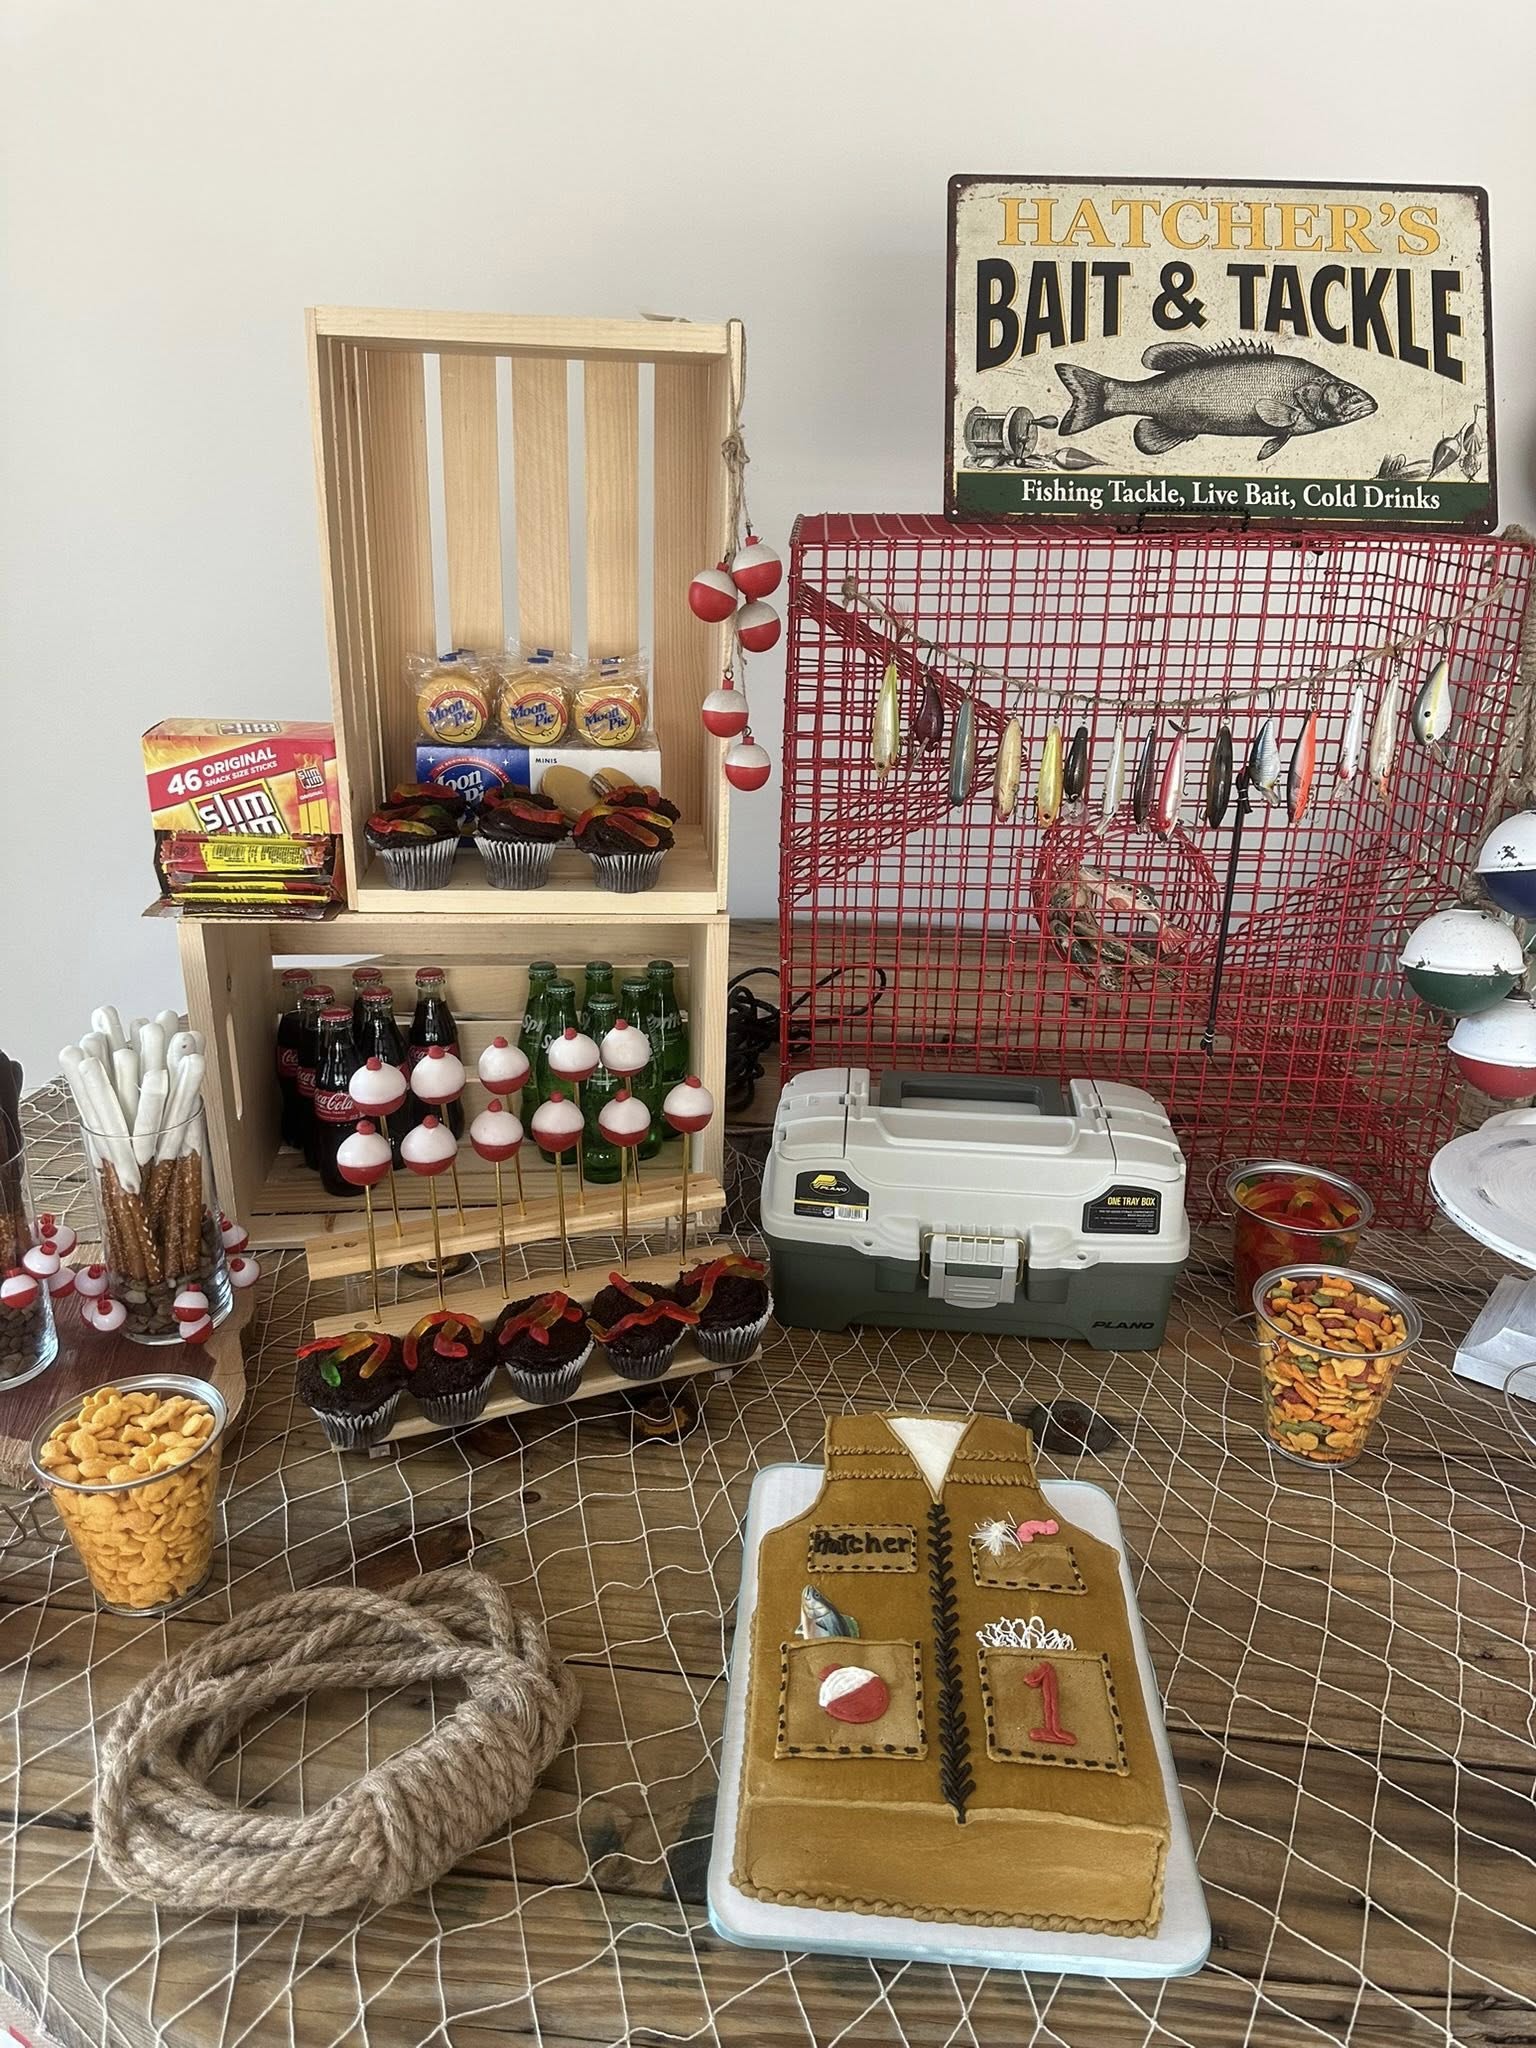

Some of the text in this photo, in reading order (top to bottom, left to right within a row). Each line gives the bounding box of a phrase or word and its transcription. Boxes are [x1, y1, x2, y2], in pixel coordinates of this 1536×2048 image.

[997, 197, 1441, 256] HATCHER’S
[976, 257, 1467, 385] BAIT & TACKLE
[1021, 478, 1440, 510] Fishing Tackle, Live Bait, Cold Drinks
[427, 700, 463, 725] Moon
[454, 709, 473, 727] Pie
[510, 702, 546, 720] Moon
[534, 712, 554, 728] Pie
[584, 707, 619, 726] Moon
[609, 716, 627, 731] Pie
[202, 747, 277, 777] ORIGINAL
[204, 760, 278, 788] SNACK SIZE STICKS
[167, 768, 203, 795] 46
[1107, 1196, 1156, 1206] ONE TRAY BOX
[1091, 1321, 1155, 1329] PLANO
[1022, 1661, 1078, 1746] 1
